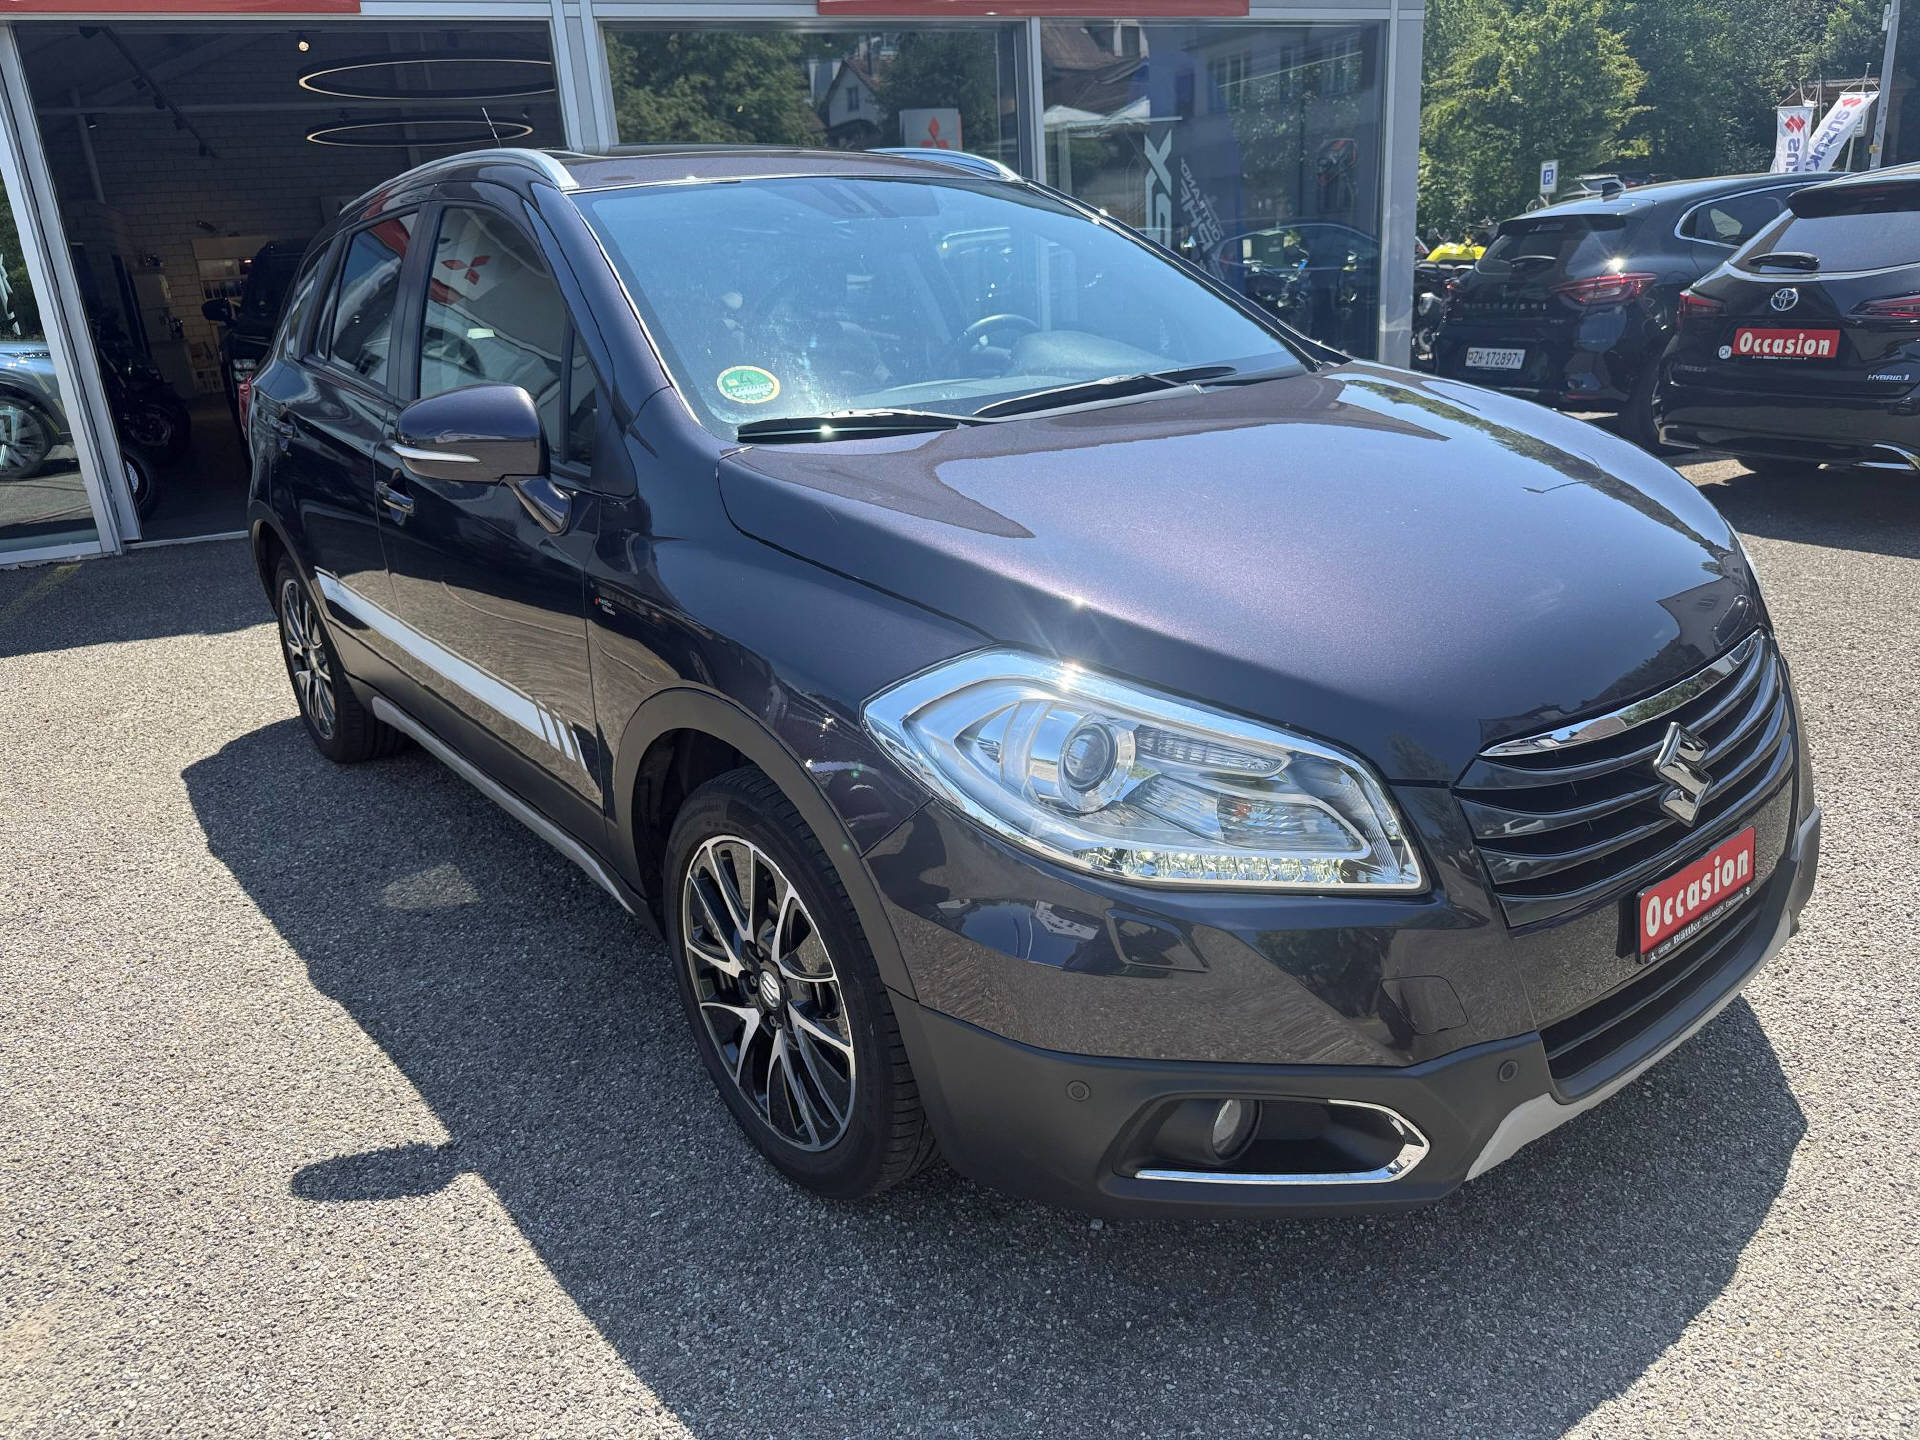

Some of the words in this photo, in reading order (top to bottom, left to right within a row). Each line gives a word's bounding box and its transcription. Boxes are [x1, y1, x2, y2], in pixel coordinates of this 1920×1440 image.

[1143, 129, 1172, 251] SX
[1739, 332, 1831, 356] Occasion
[1646, 849, 1749, 937] Occasion
